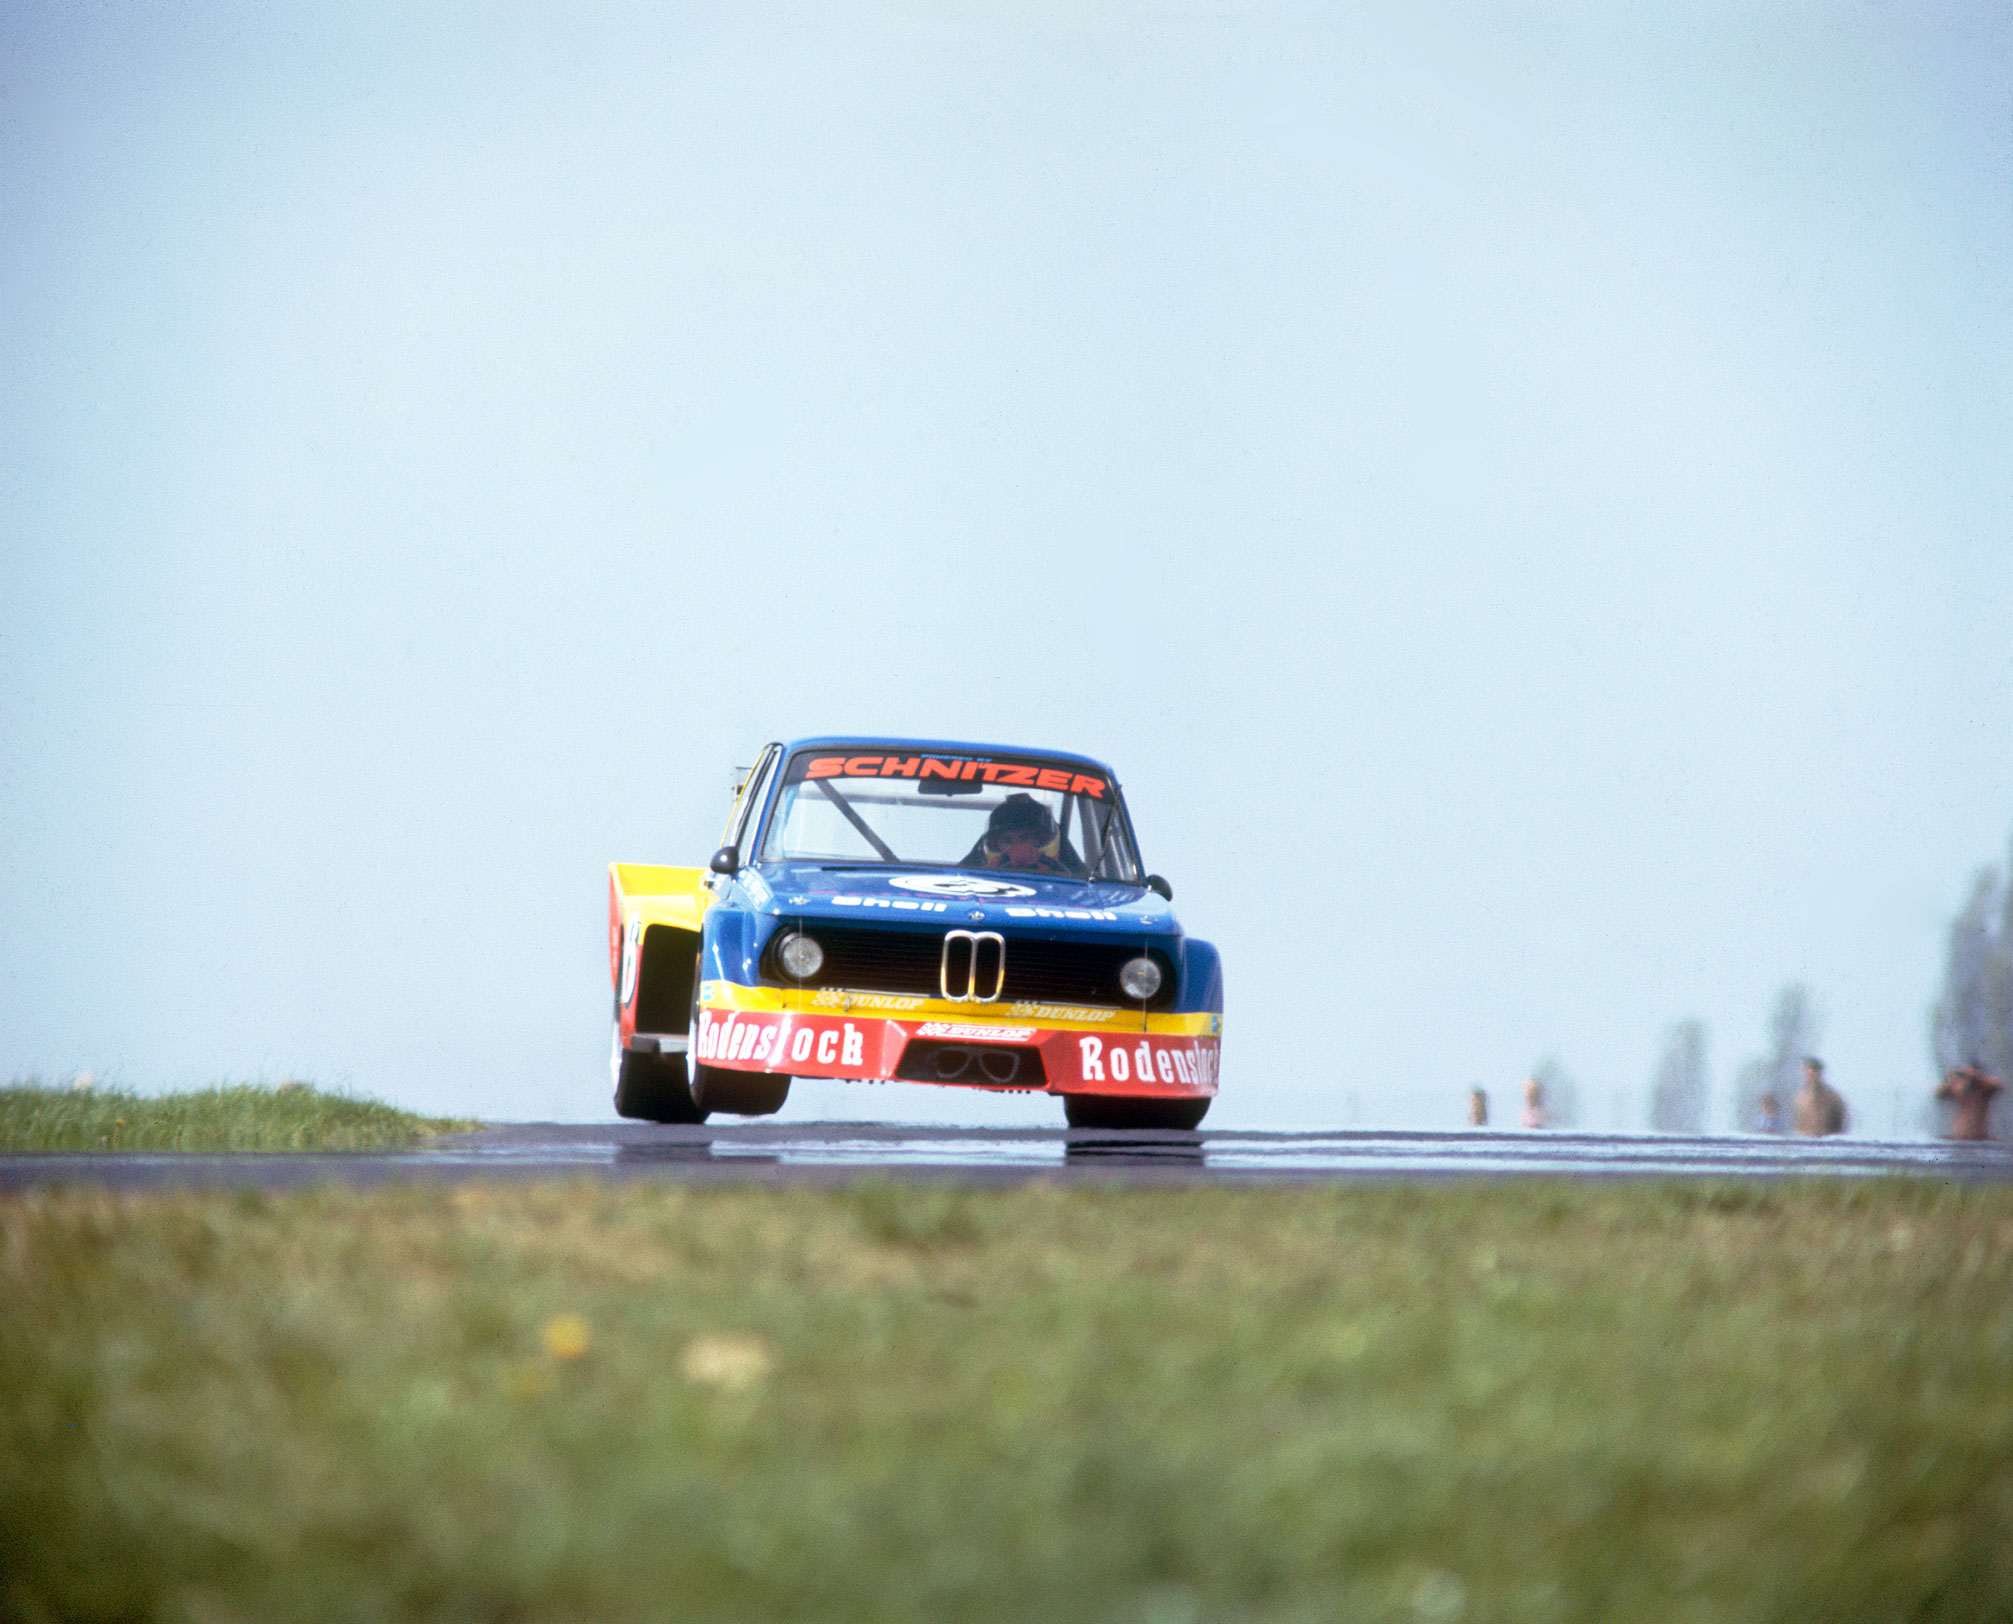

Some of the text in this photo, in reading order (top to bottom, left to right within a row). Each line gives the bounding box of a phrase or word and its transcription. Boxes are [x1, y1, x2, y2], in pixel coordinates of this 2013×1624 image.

[806, 757, 1107, 799] SCHNITZER
[832, 896, 948, 913] Shell
[1005, 908, 1117, 921] Shell
[844, 993, 924, 1010] DUNLOP
[1037, 1005, 1116, 1022] DUNLOP
[948, 1026, 1033, 1039] DUNLOP
